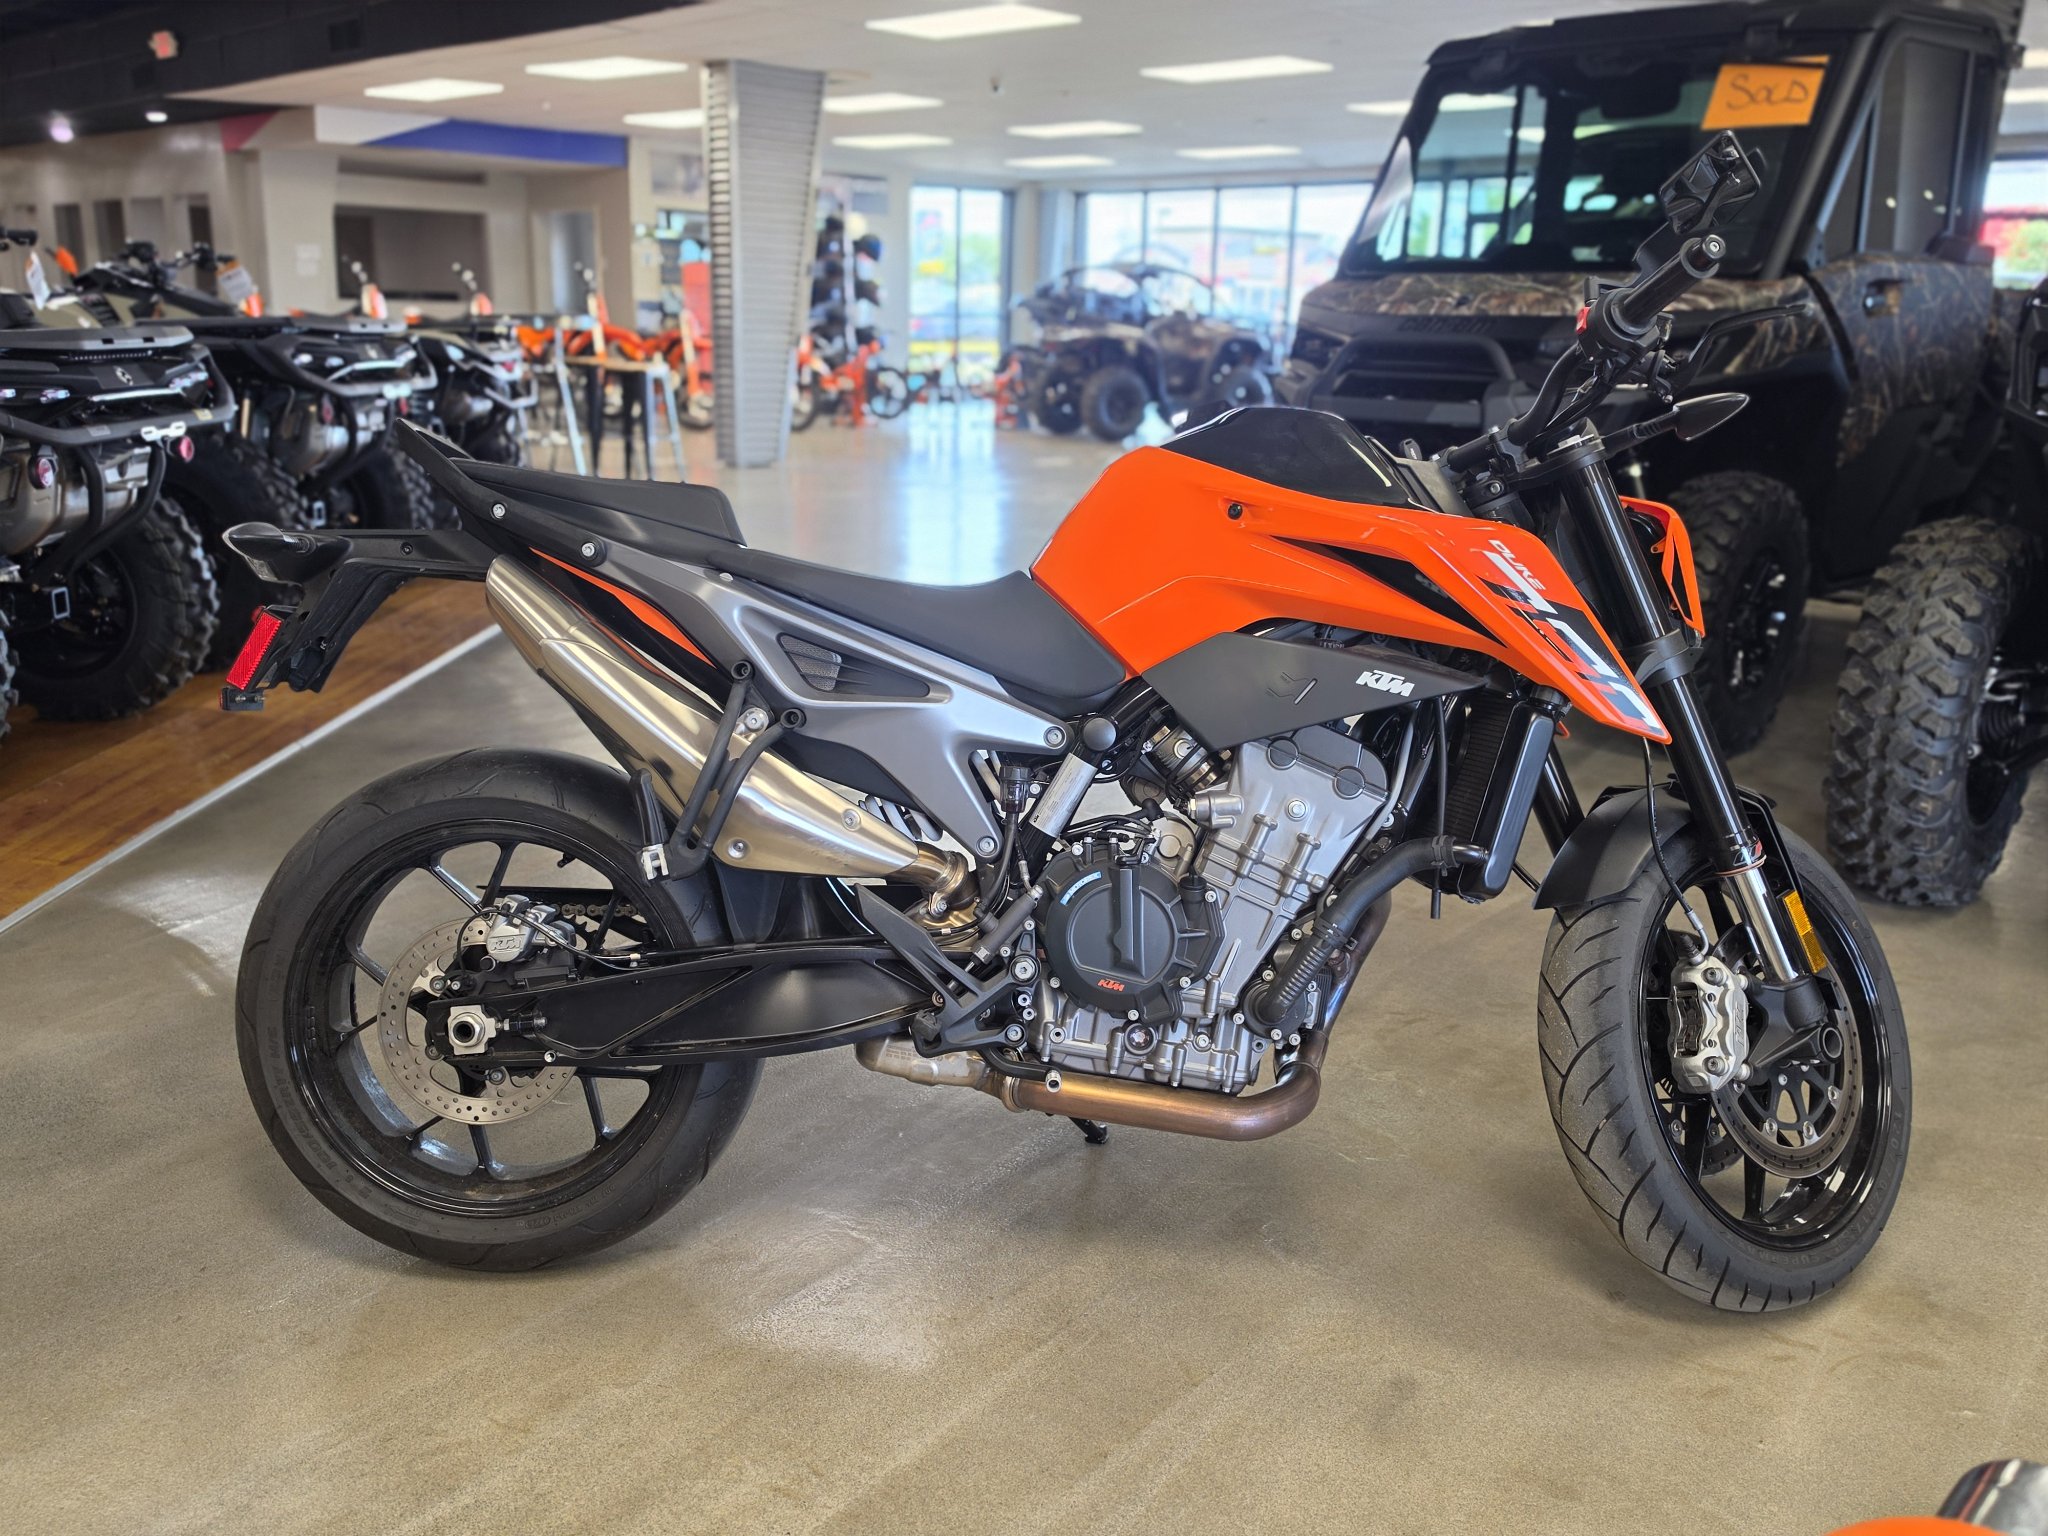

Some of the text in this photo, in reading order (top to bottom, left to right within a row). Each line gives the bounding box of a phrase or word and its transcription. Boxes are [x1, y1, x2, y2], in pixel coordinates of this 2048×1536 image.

[1488, 539, 1547, 591] DUKE
[1355, 669, 1416, 697] KTM
[489, 935, 523, 953] KTM
[1098, 978, 1125, 993] KTM
